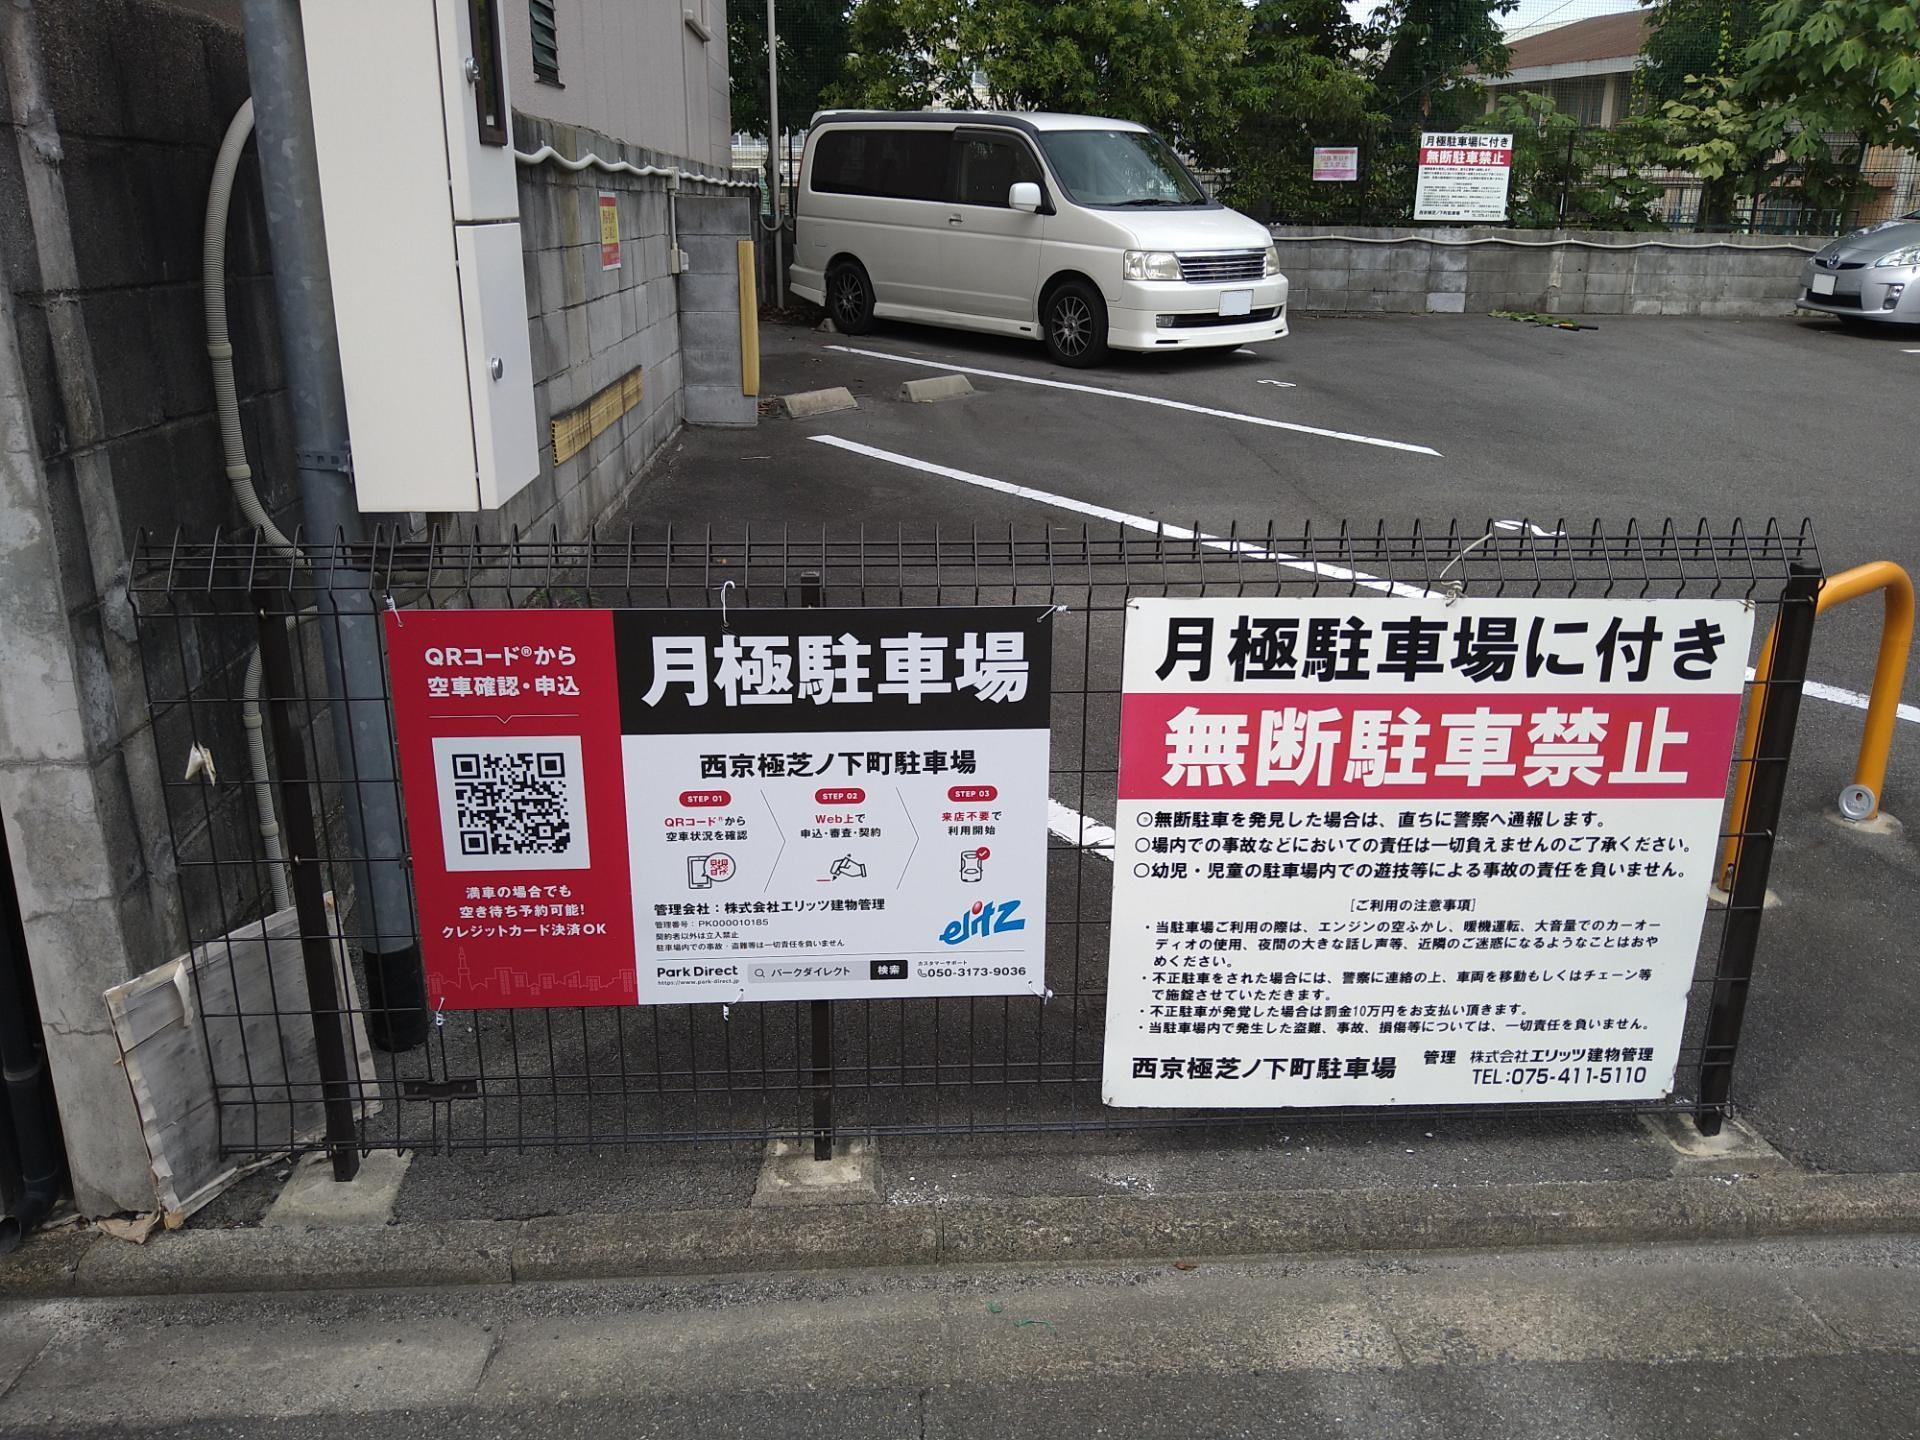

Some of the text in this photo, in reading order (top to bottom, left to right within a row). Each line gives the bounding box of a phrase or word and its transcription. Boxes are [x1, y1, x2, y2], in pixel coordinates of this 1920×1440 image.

[1425, 135, 1508, 147] 月極駐車場に付き
[1426, 150, 1505, 165] 無断駐車禁止
[1154, 615, 1727, 684] 月極駐車場に付き
[641, 631, 1030, 708] 月極駐車場
[427, 675, 581, 697] 空車確認・申込
[1161, 705, 1690, 788] 無断駐車禁止
[699, 749, 977, 779] 西京極芝ノ下町駐車場
[687, 795, 723, 803] STEP 01
[846, 792, 858, 800] 02
[955, 790, 977, 798] STEP
[815, 813, 866, 824] Web上で
[942, 811, 1002, 822] 来店不要で
[665, 830, 748, 842] 空車状況を確認
[800, 827, 881, 839] 申込・審査・契約
[948, 825, 996, 836] 利用開始
[466, 884, 572, 899] 満車の場合でも
[459, 903, 585, 919] 空き待ち予約可能!
[939, 899, 1026, 945] elitz
[442, 923, 607, 938] クレジットカード決済OK
[655, 931, 739, 941] 契約者以外は立入禁止
[1153, 955, 1234, 968] めください。
[657, 965, 739, 978] Park Direct
[771, 966, 851, 978] パークダイレクト
[877, 964, 901, 976] 検索
[927, 966, 1027, 978] 050-3173-9036
[1151, 988, 1332, 1001] で施錠させていただきます。
[1423, 1047, 1654, 1065] 管理 株式会社エリッツ建物管理
[1131, 1056, 1398, 1080] 西京極芝ノ下町駐車場
[1472, 1066, 1647, 1085] TEL:075-411-5110
